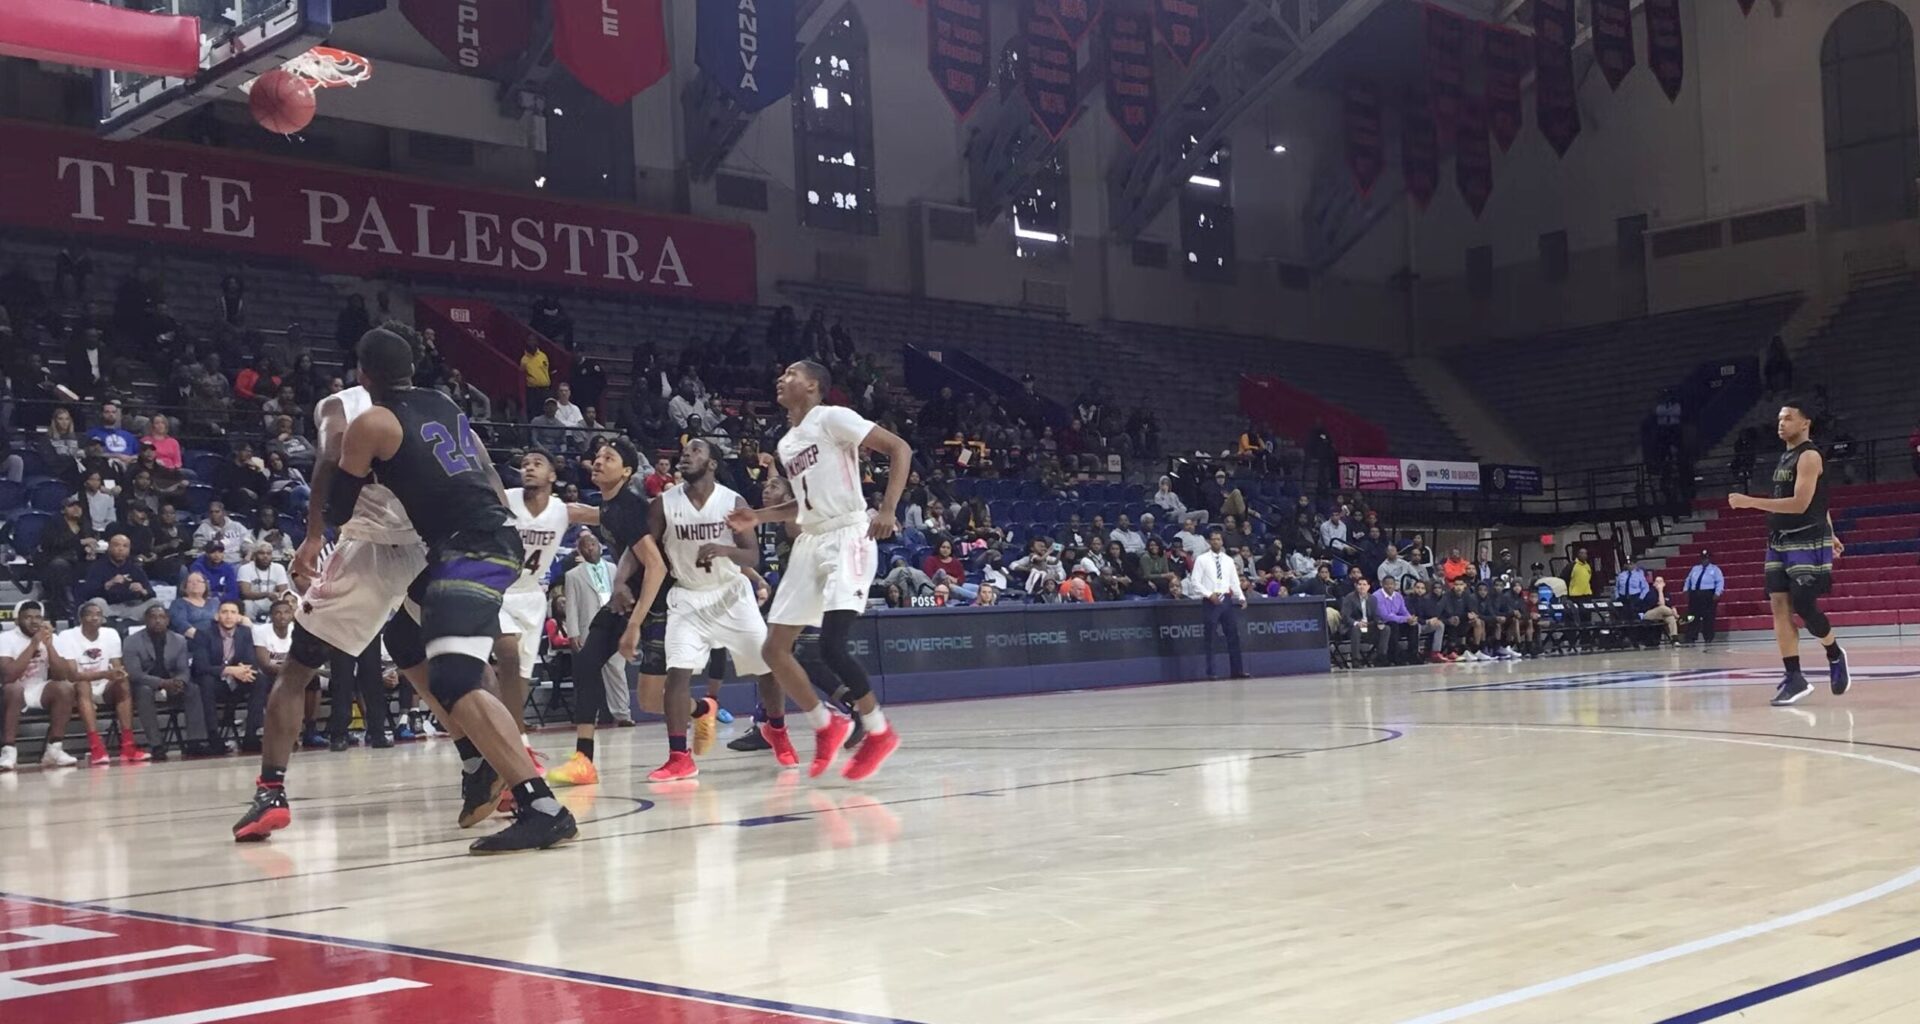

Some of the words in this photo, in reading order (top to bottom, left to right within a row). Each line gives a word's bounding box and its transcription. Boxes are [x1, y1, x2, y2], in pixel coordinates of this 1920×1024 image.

[602, 0, 620, 37] LE
[457, 0, 480, 68] PHS
[738, 0, 759, 92] ANOVA
[57, 156, 255, 238] THE
[300, 188, 693, 288] PALESTRA
[420, 413, 484, 477] 24
[1440, 468, 1450, 480] 98
[801, 475, 813, 511] 1
[519, 529, 556, 546] HOTEP
[675, 521, 725, 541] IMHOTEP
[695, 556, 713, 574] 4
[911, 596, 936, 608] POSS
[1079, 626, 1152, 642] POWERADE
[1247, 618, 1321, 635] POWERADE
[884, 635, 974, 652] POWERADE
[986, 631, 1068, 648] POWERADE
